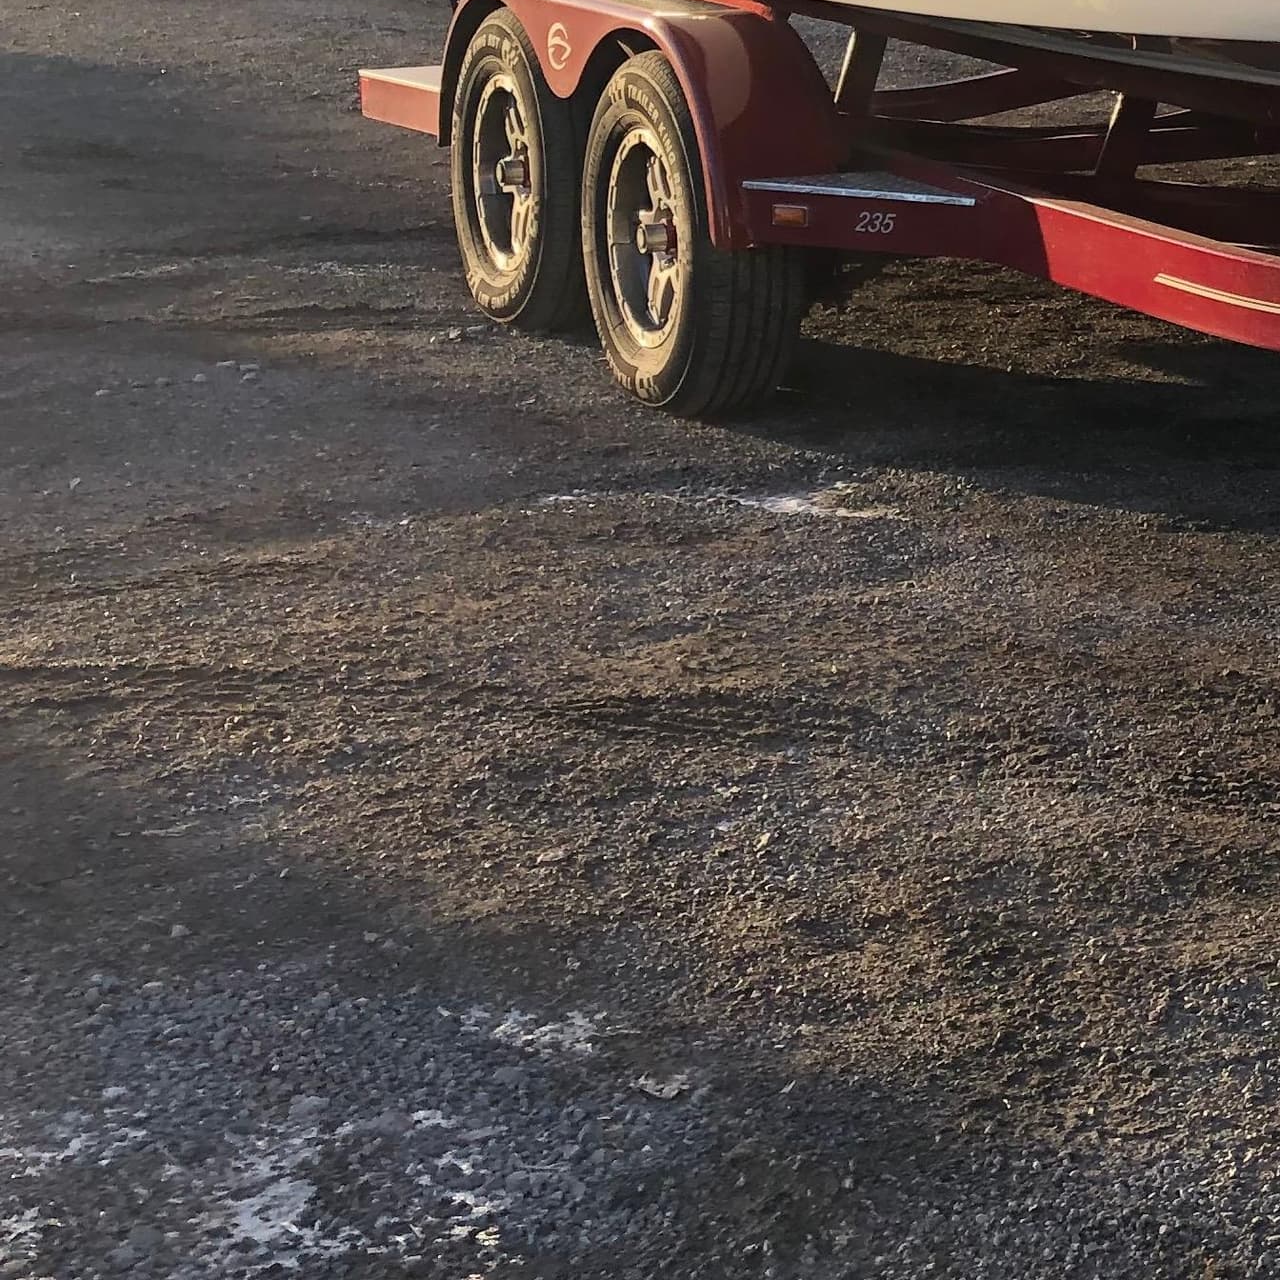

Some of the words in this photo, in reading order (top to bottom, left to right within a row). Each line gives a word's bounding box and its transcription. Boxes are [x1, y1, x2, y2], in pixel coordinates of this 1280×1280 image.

[627, 83, 659, 124] TRAILER
[657, 121, 676, 166] KING
[855, 211, 897, 234] 235
